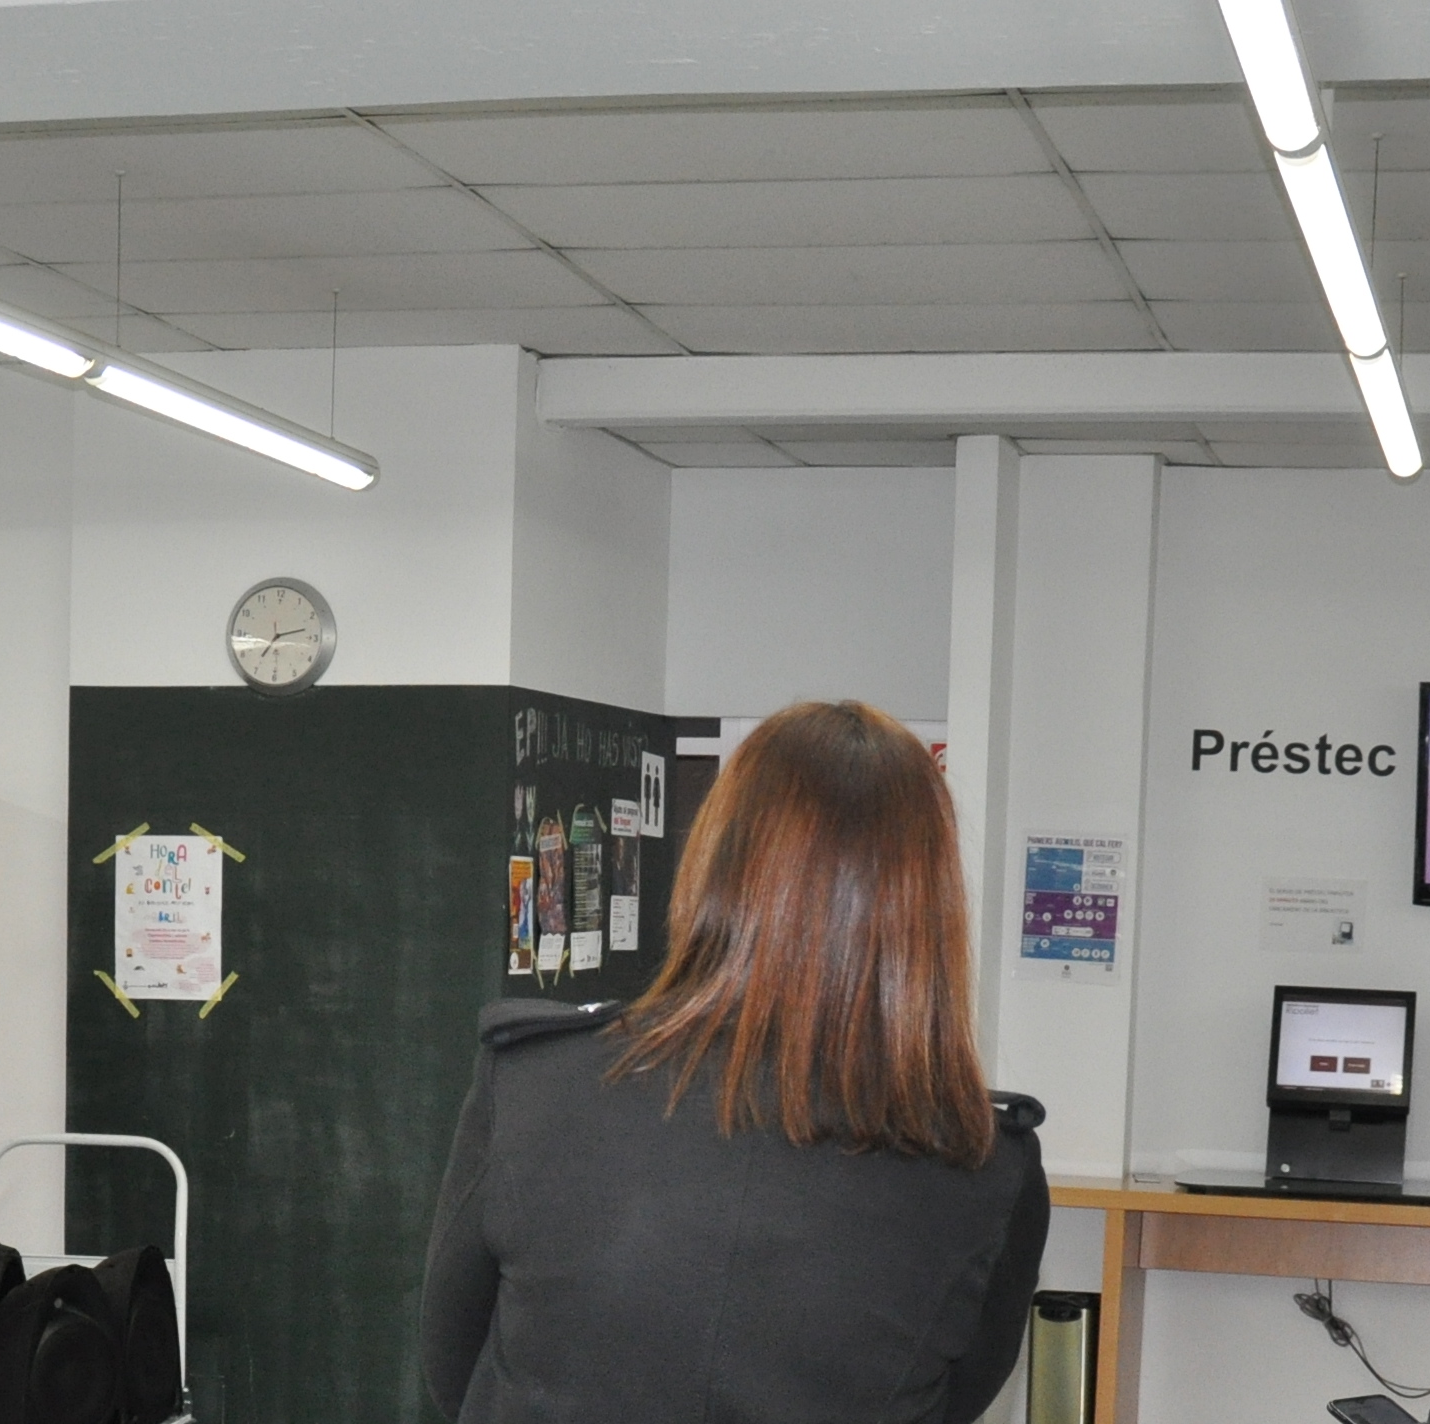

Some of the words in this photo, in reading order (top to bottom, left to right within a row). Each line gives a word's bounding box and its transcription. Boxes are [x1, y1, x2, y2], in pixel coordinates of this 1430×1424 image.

[277, 590, 285, 598] 12
[258, 595, 266, 603] 11
[242, 609, 250, 617] 10
[1191, 727, 1397, 777] Préstec
